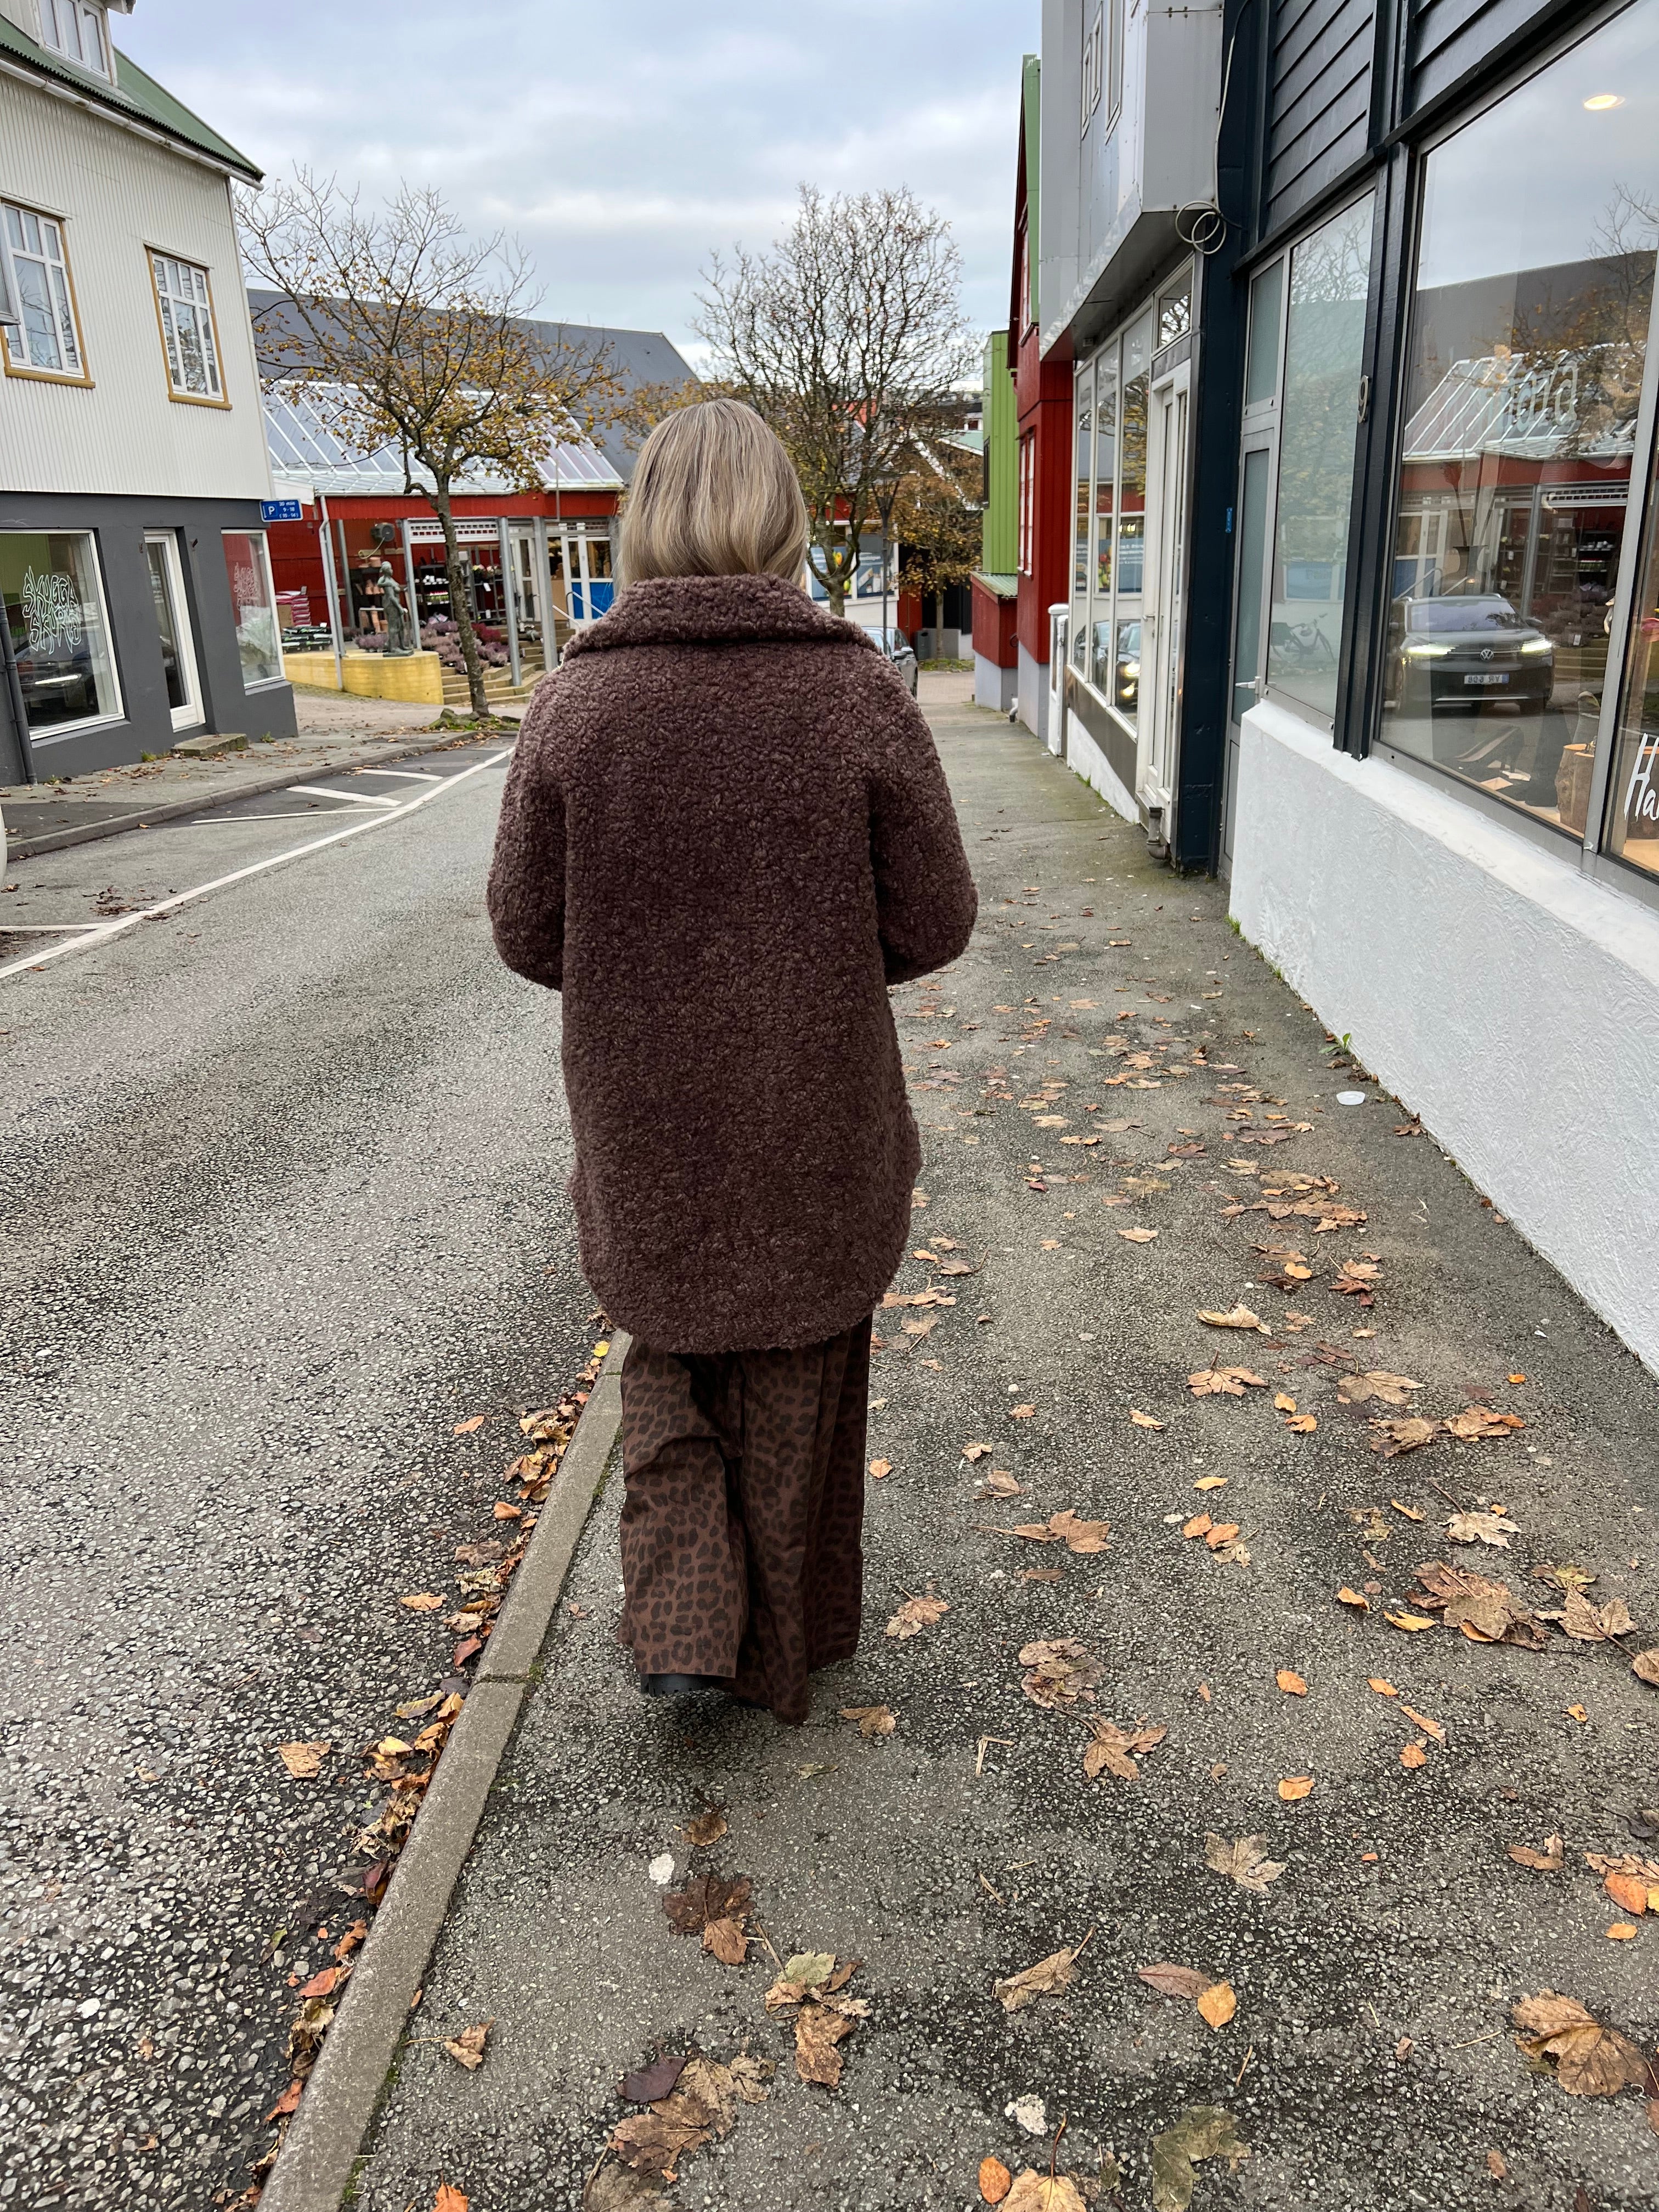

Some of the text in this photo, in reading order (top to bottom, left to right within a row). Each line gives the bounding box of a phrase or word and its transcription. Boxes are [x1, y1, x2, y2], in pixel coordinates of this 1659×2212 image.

[1357, 375, 1369, 424] 9
[268, 506, 275, 515] P
[1623, 733, 1659, 822] Ha
